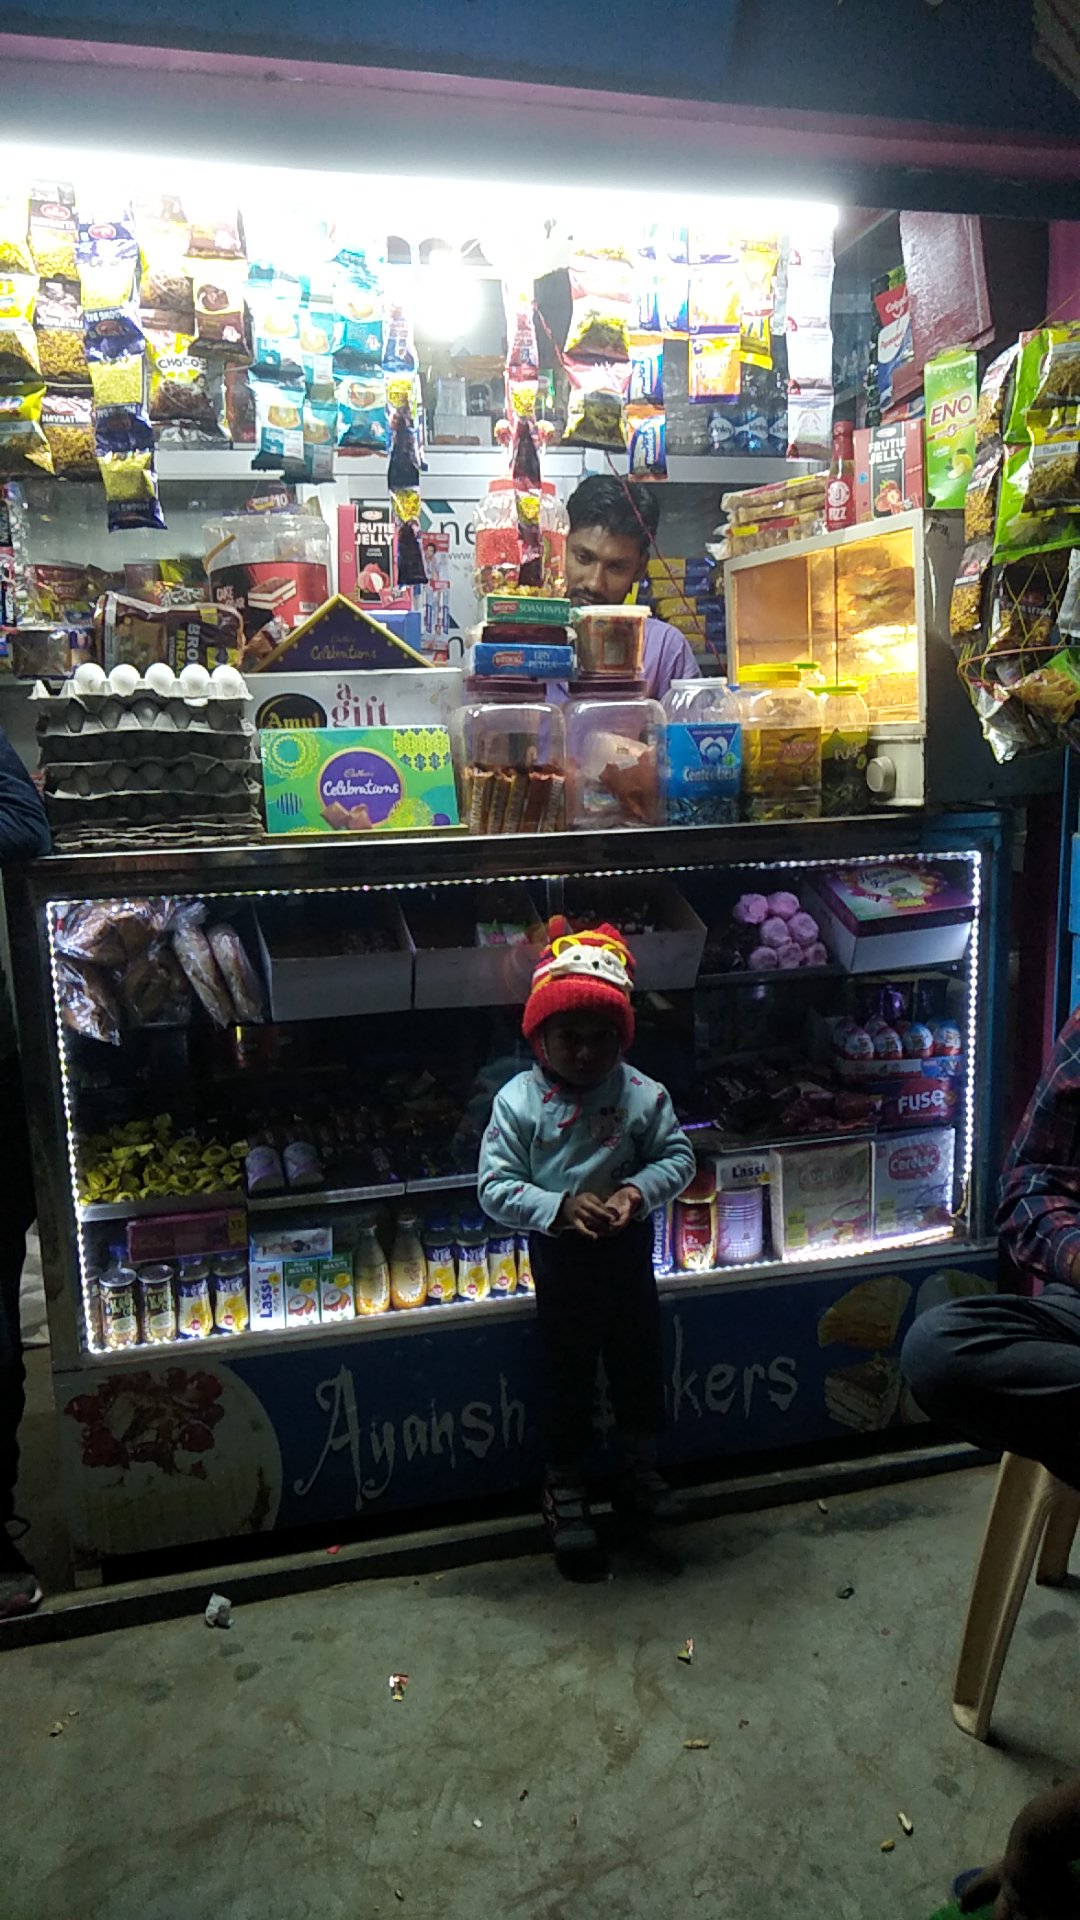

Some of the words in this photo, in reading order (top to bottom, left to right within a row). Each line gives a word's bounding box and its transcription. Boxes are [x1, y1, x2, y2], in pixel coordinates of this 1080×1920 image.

[157, 358, 207, 372] CHOCOS
[931, 395, 973, 425] ENO
[868, 436, 907, 453] FRUTIE
[868, 448, 907, 465] JELLY
[353, 522, 396, 534] FRUTIE
[353, 534, 395, 546] JELLY
[175, 629, 187, 668] BREA
[336, 682, 352, 701] a
[331, 695, 389, 727] gift
[322, 778, 400, 797] Celebrations
[898, 1088, 946, 1114] FUSE
[731, 1163, 766, 1179] Lassi
[890, 1154, 938, 1173] Cerelac
[259, 1278, 273, 1318] Lassi
[294, 1363, 527, 1512] Ayansh
